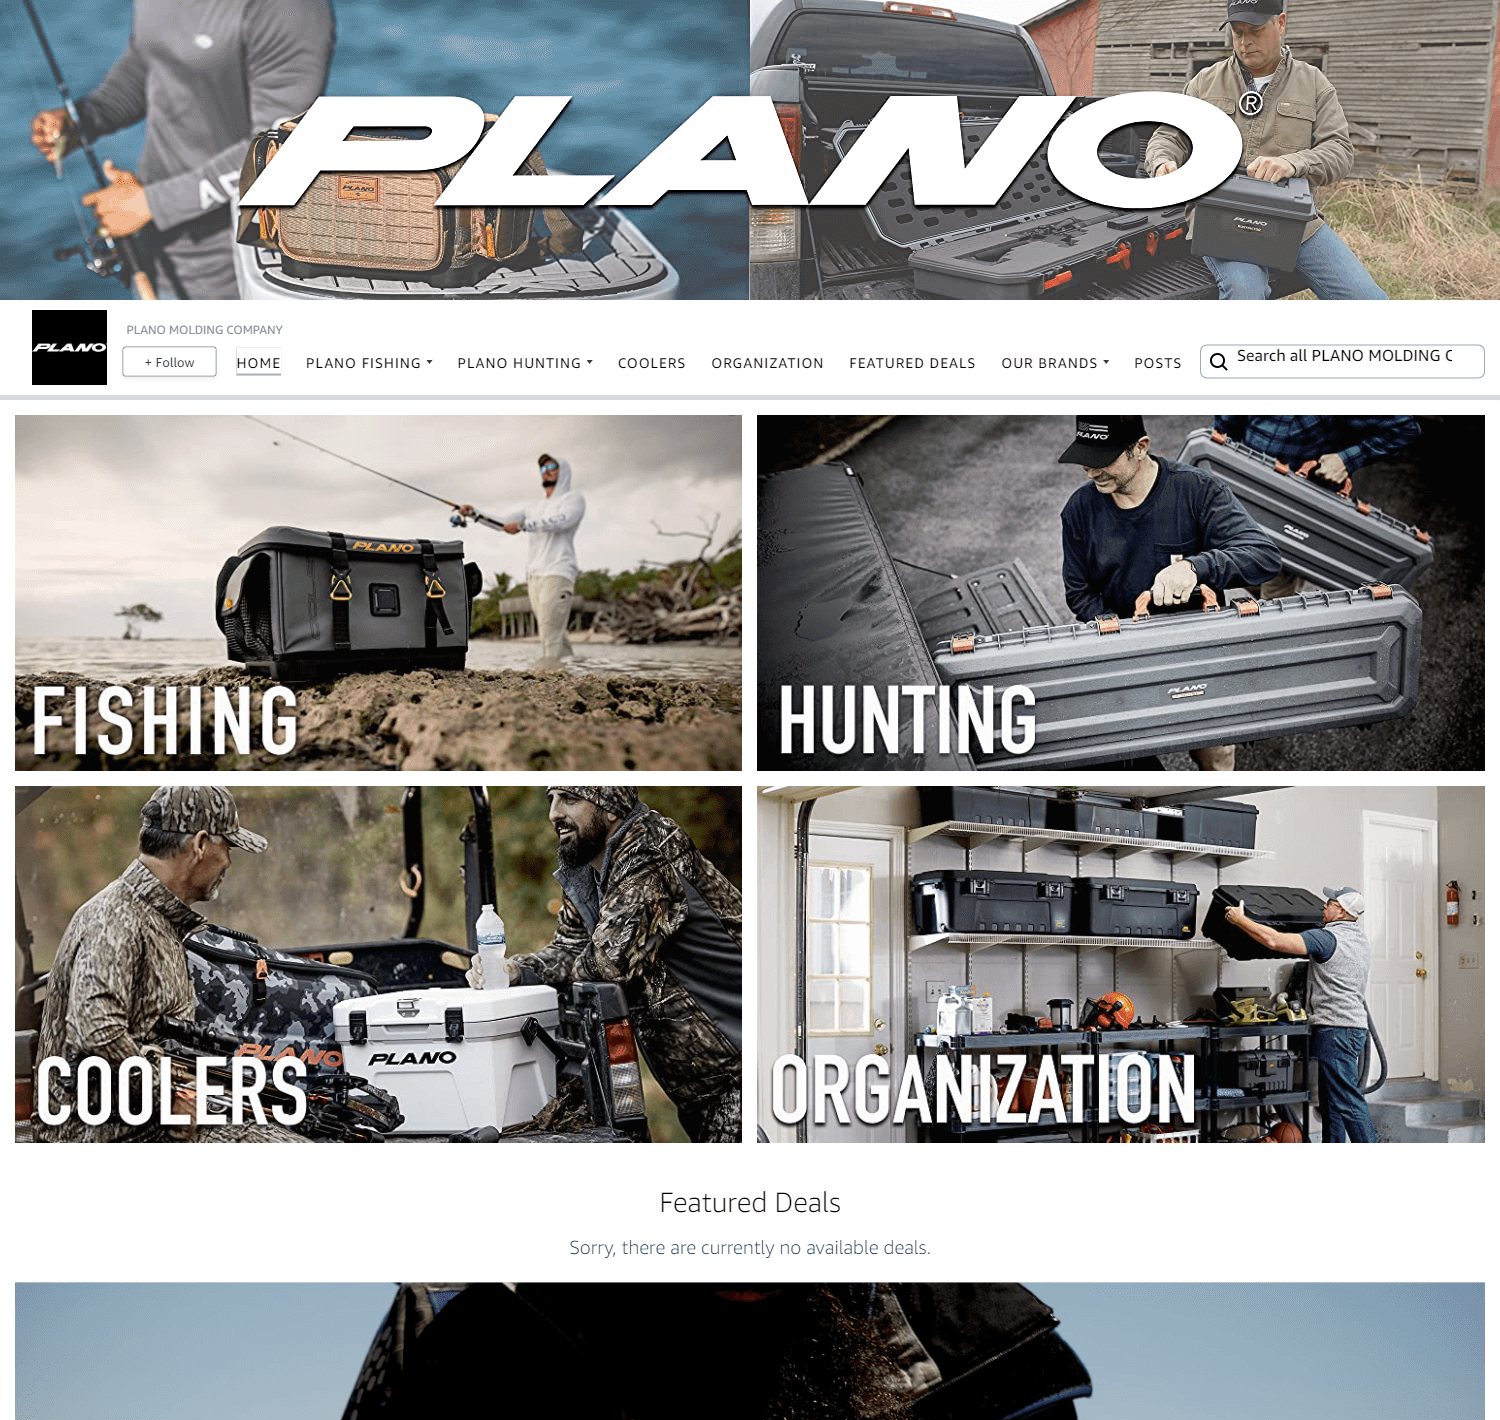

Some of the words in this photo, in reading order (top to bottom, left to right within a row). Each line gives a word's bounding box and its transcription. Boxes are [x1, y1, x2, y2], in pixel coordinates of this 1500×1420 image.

[126, 324, 165, 335] PLANO
[169, 324, 224, 335] MOLDING
[226, 324, 283, 335] COMPANY
[32, 343, 107, 352] PLANO
[1237, 348, 1286, 362] Search
[1289, 348, 1308, 362] all
[1312, 349, 1364, 362] PLANO
[1369, 349, 1441, 362] MOLDING
[156, 356, 195, 368] Follow
[237, 357, 281, 369] HOME
[306, 357, 356, 369] PLANO
[362, 357, 421, 369] FISHING
[458, 357, 508, 369] PLANO
[513, 357, 581, 369] HUNTING
[618, 357, 686, 369] COOLERS
[711, 357, 823, 369] ORGANIZATION
[849, 357, 924, 369] FEATURED
[930, 357, 976, 369] DEALS
[1001, 357, 1033, 369] OUR
[1038, 357, 1098, 369] BRANDS
[1134, 357, 1182, 369] POSTS
[353, 541, 414, 553] PLANO
[368, 1050, 457, 1066] PLANO
[661, 1190, 766, 1213] Featured
[776, 1190, 841, 1213] Deals
[569, 1239, 616, 1259] Sorry,
[621, 1239, 666, 1255] there
[670, 1243, 697, 1255] are
[701, 1239, 775, 1259] currently
[780, 1243, 801, 1255] no
[806, 1239, 879, 1255] available
[883, 1239, 931, 1255] deals.
